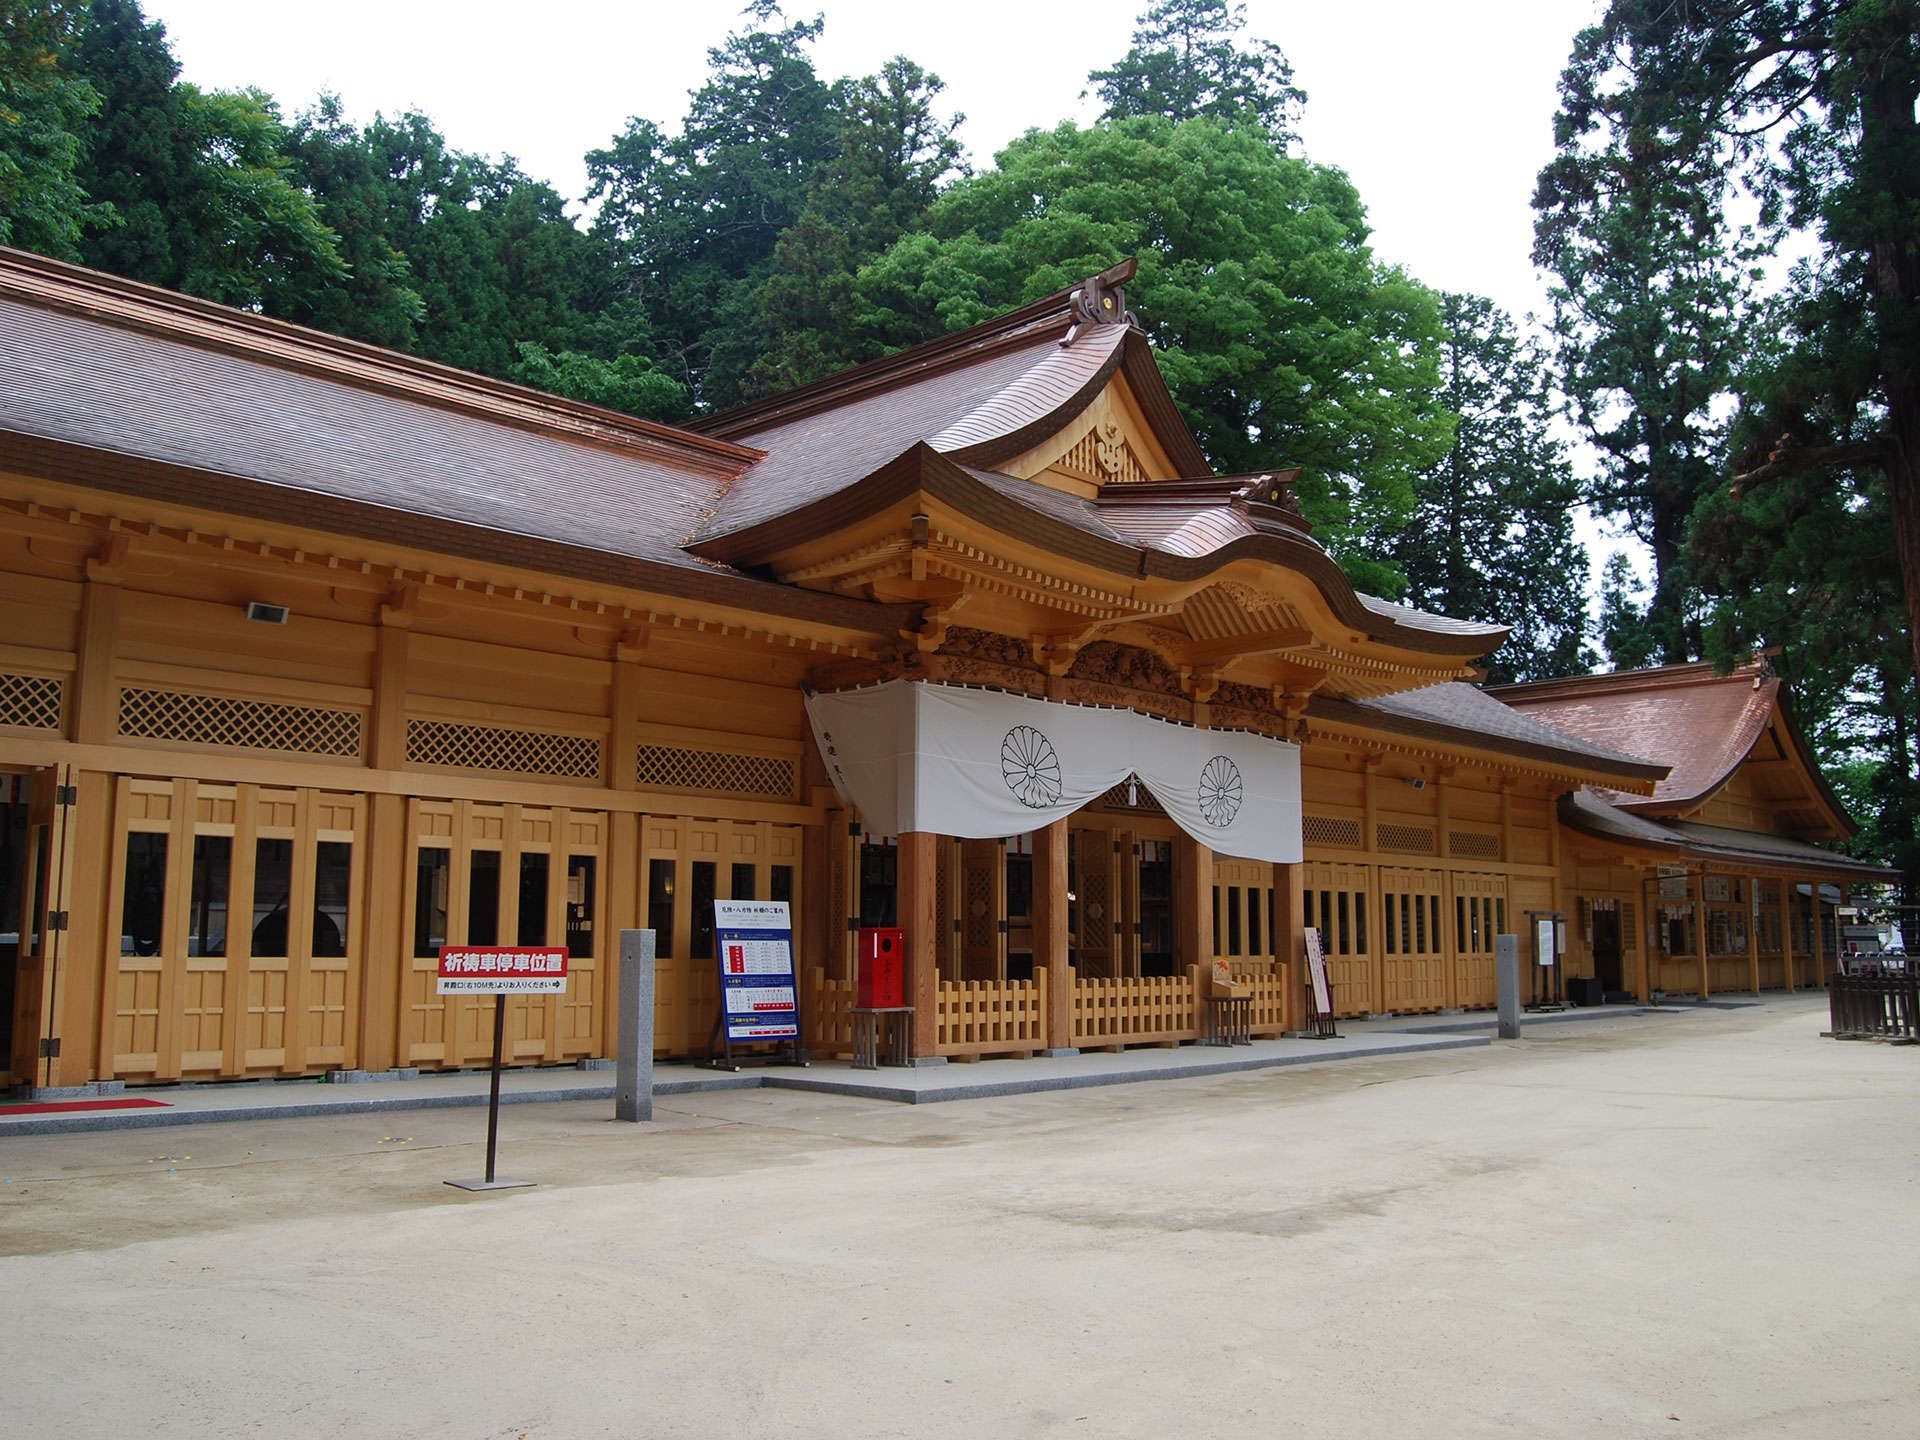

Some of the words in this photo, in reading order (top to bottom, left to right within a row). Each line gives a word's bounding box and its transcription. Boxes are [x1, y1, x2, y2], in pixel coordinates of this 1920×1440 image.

[445, 953, 562, 972] 祈祷車停車位置
